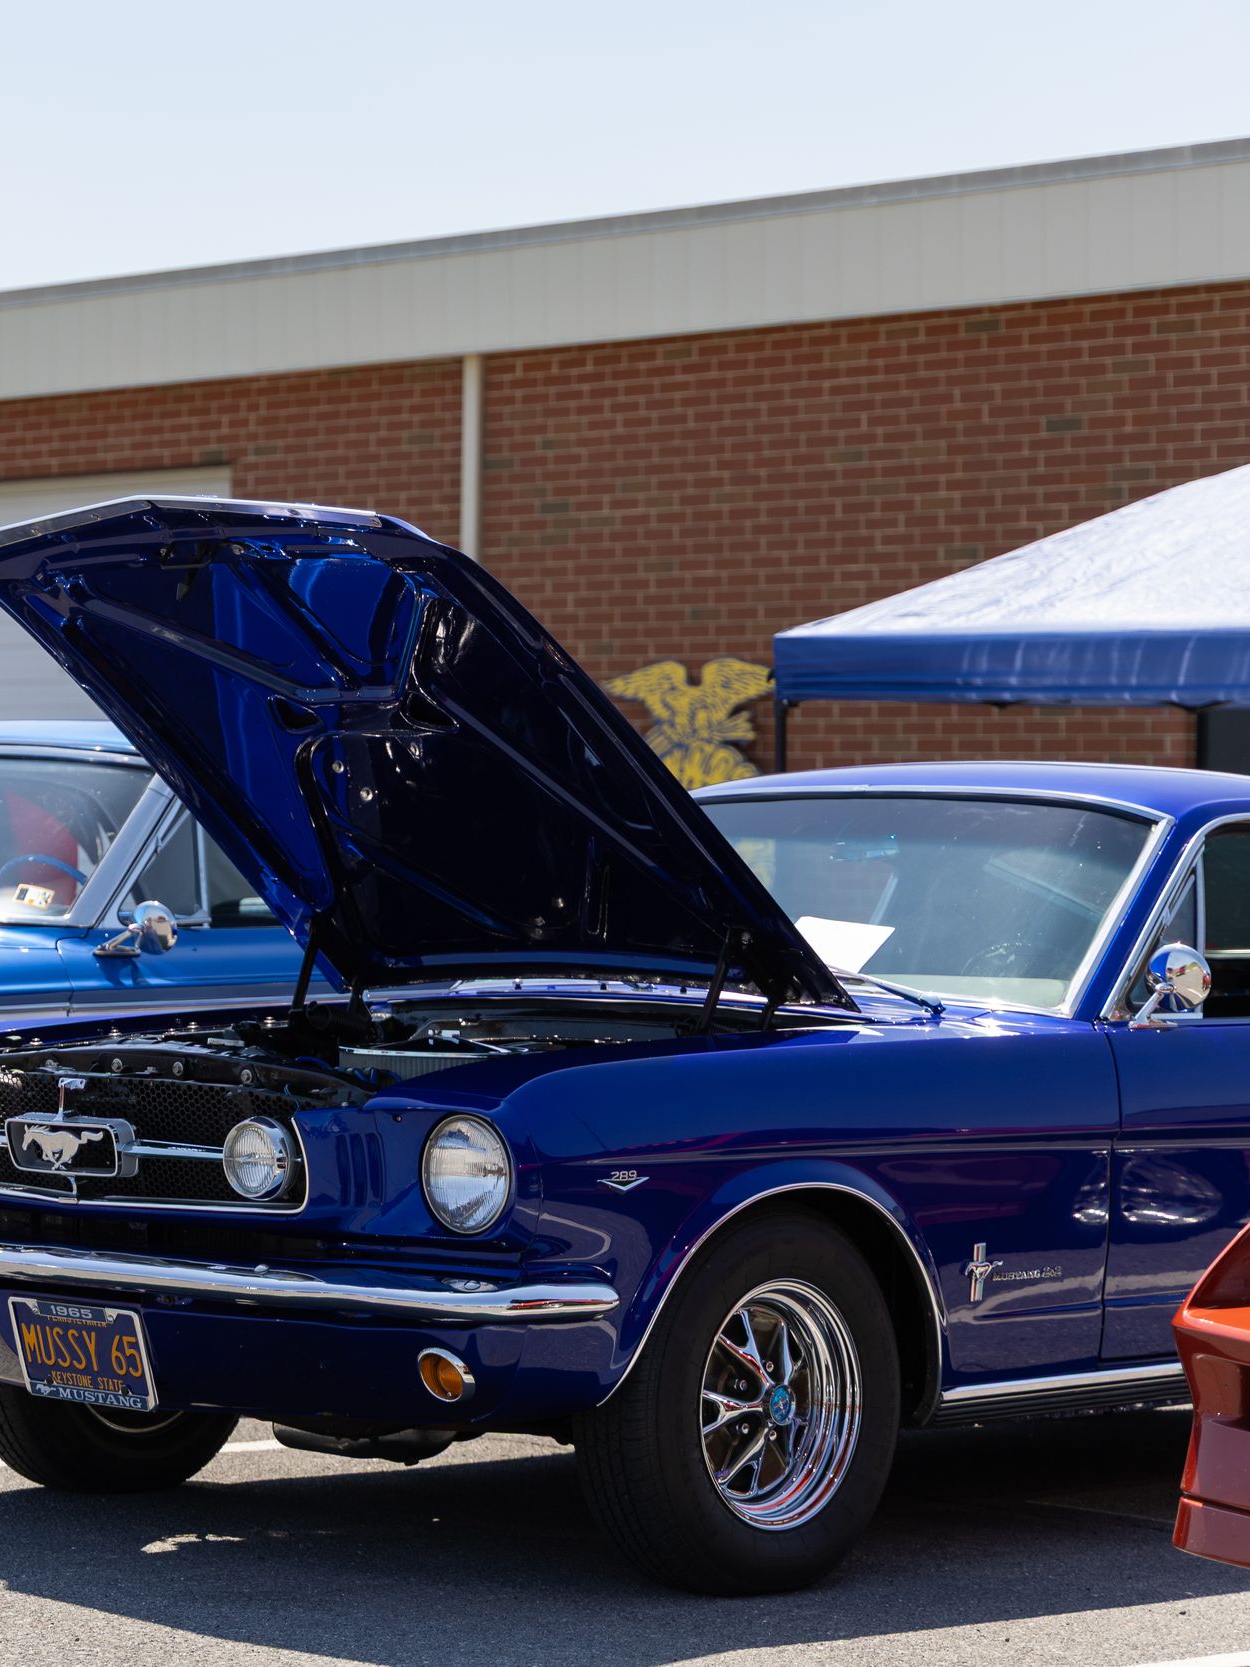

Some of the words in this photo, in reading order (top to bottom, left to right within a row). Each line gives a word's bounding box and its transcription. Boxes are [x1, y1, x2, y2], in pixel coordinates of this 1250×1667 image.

[610, 1170, 638, 1181] 289
[992, 1269, 1041, 1281] MUSTANG
[50, 1304, 93, 1319] 1965
[21, 1322, 99, 1372] MUSSY
[111, 1334, 143, 1377] 65
[51, 1370, 93, 1388] KEYSTONE
[97, 1377, 124, 1393] STATE
[58, 1387, 142, 1409] MUSTANG
